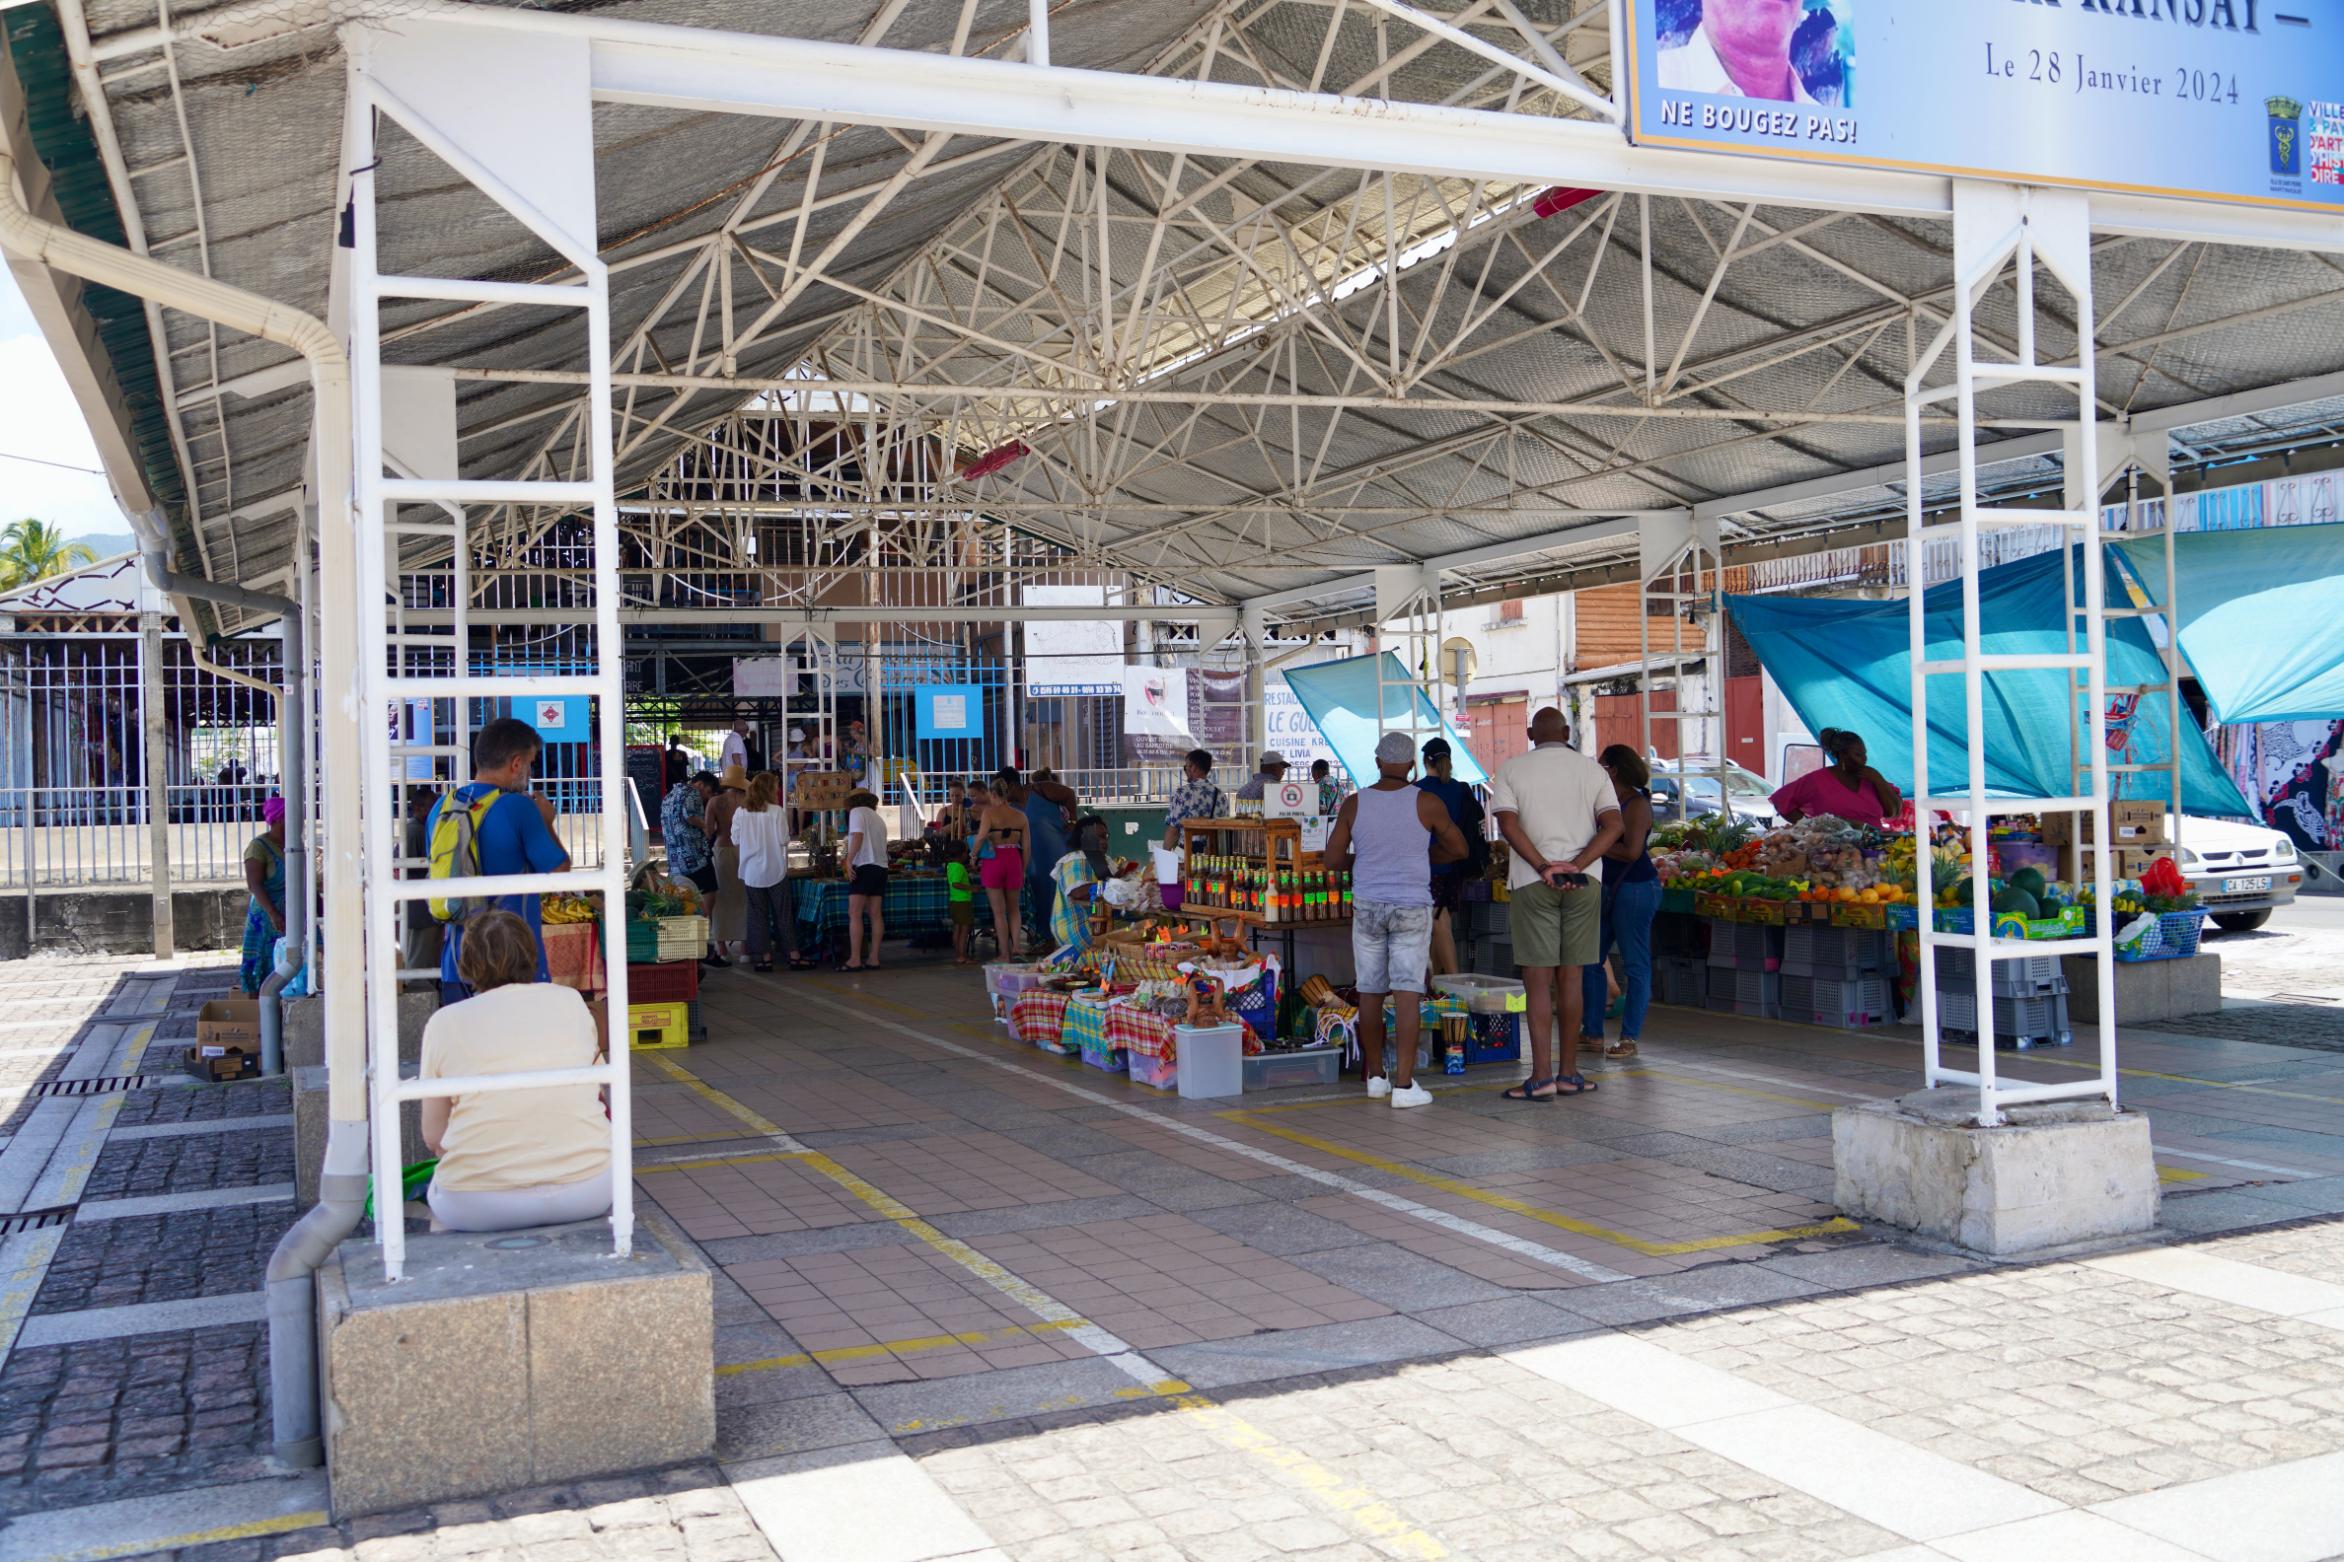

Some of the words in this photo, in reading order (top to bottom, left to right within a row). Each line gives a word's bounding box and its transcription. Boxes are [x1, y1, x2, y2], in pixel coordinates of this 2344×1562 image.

[1985, 42, 2015, 77] Le
[2029, 49, 2061, 83] 28
[2076, 54, 2162, 95] Janvier
[2176, 68, 2239, 105] 2024
[1661, 99, 1692, 126] NE
[1703, 103, 1797, 137] BOUGEZ
[1806, 115, 1857, 143] PAS!
[1268, 711, 1285, 733] LE
[1290, 749, 1311, 758] LIVIA
